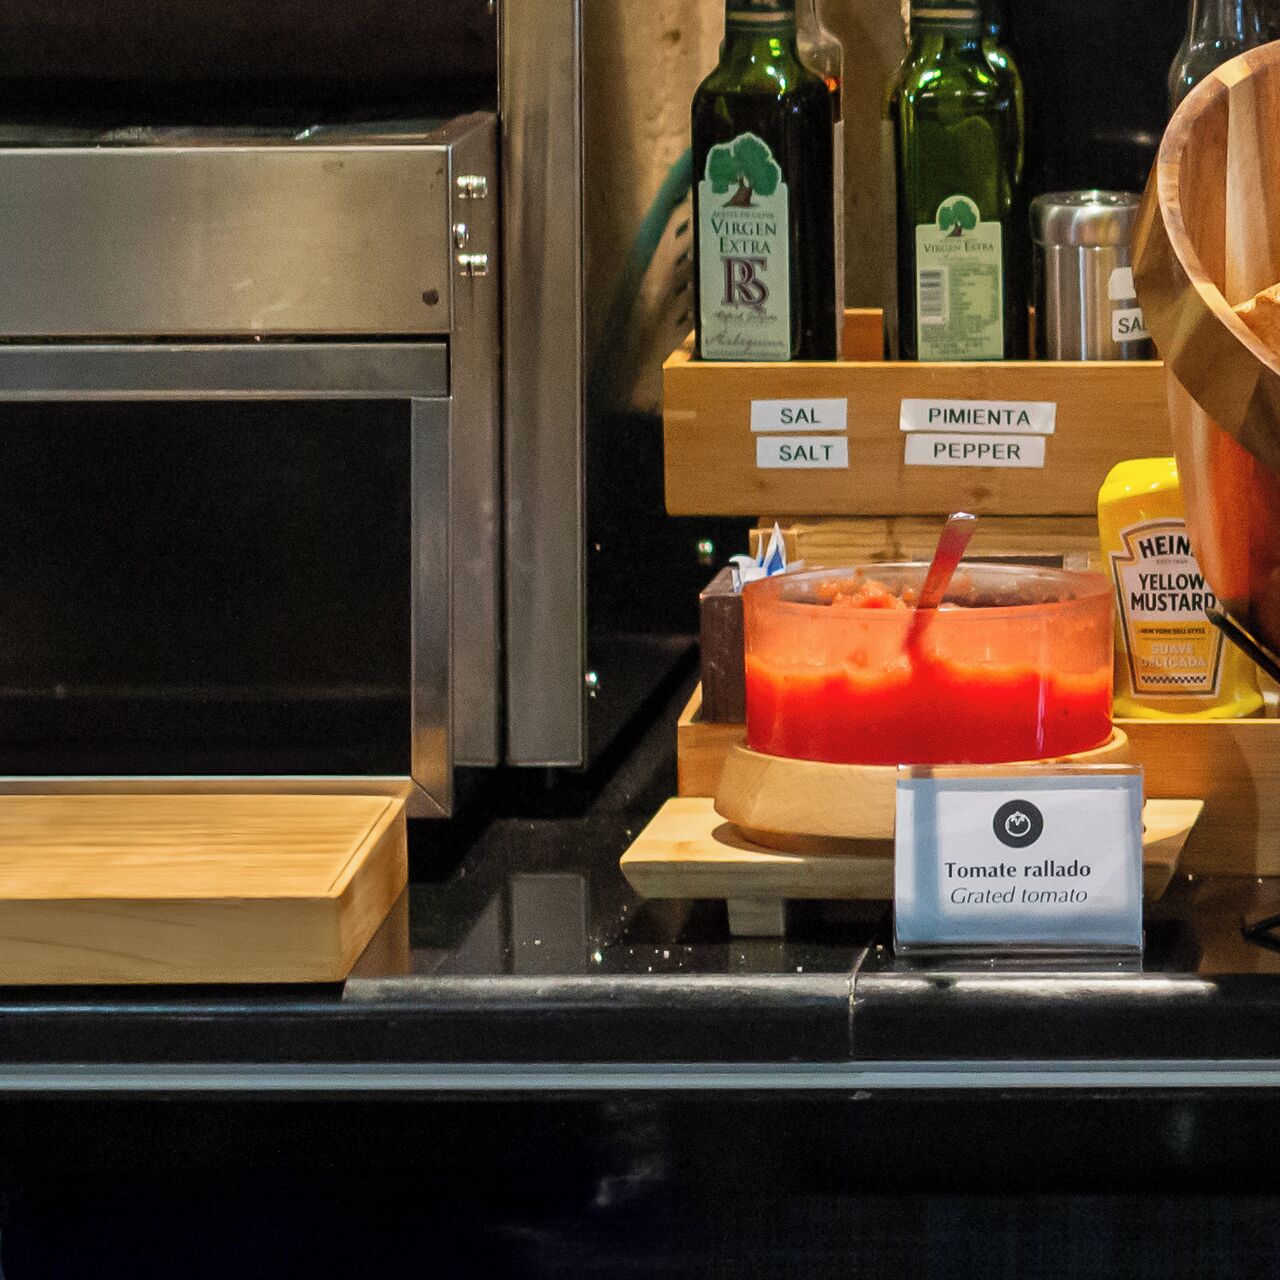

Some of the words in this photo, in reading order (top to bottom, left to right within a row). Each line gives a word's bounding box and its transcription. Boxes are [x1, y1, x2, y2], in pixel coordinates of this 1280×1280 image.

[711, 218, 777, 236] VIRGEN
[719, 236, 772, 254] EXTRA
[780, 407, 821, 424] SAL
[928, 407, 1031, 426] PIMIENTA
[779, 444, 834, 461] SALT
[932, 442, 1021, 460] PEPPER
[1138, 534, 1195, 560] HEIN
[1138, 573, 1205, 591] YELLOW
[1130, 592, 1216, 612] MUSTARD
[944, 862, 1017, 878] Tomate
[1023, 859, 1091, 878] rallado
[951, 886, 1016, 904] Grated
[1021, 887, 1088, 904] tomato
